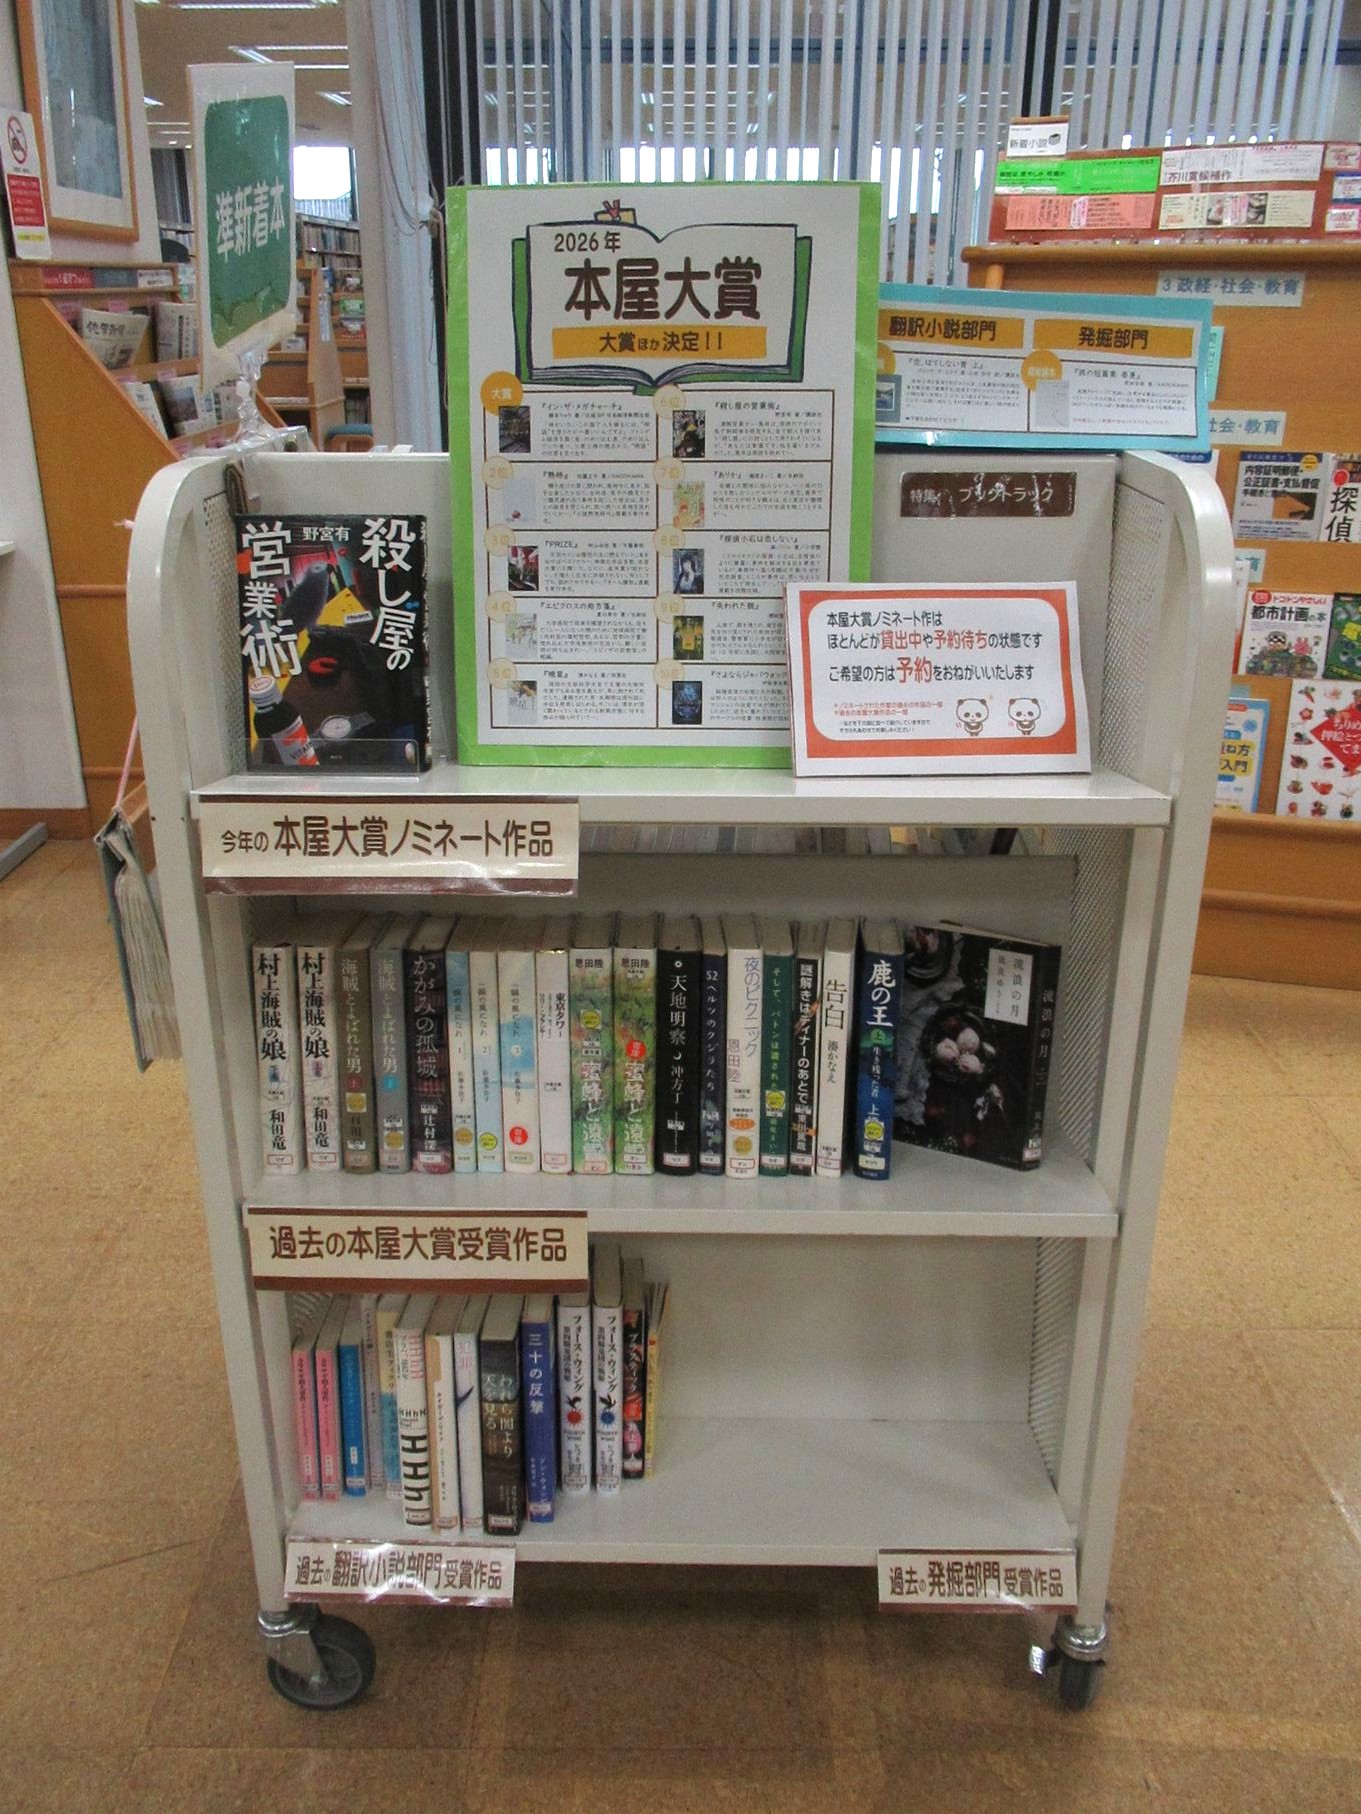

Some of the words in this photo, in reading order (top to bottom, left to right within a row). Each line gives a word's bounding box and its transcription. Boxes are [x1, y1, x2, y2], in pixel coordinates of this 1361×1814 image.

[215, 177, 285, 260] 準新着本
[554, 231, 621, 253] 2026年
[564, 256, 762, 321] 本屋大賞
[889, 316, 997, 342] 翻訳小説部門
[1078, 326, 1149, 350] 発掘部門
[491, 388, 512, 400] 大賞
[302, 526, 351, 542] 野宮有
[1325, 487, 1359, 542] 探偵
[240, 521, 302, 678] 営業術
[359, 517, 416, 671] 殺し屋の
[1251, 606, 1328, 622] 都市計画の本
[826, 611, 943, 627] 本屋大賞ノミネート作は
[827, 630, 1042, 650] ほとんどが貸出中や予約待ちの状態です
[829, 657, 1035, 683] ご希望の方は予約をおねがいいたします
[1220, 743, 1250, 756] ね方
[1220, 760, 1248, 773] 入門
[221, 815, 554, 858] 今年の本屋大賞ノミネート作品
[257, 952, 287, 1060] 村上海賊の娘
[301, 952, 330, 1060] 村上海賊の娘
[341, 958, 362, 1074] 海賊とよばれた男
[413, 956, 439, 1079] かがみの孤城
[556, 993, 566, 1038] 東京タワー
[669, 974, 687, 1045] 天地明察
[744, 956, 761, 1057] 夜のピクニック
[824, 979, 848, 1030] 告白
[866, 959, 896, 1028] 鹿の王
[705, 970, 719, 1091] 52ヘルツのクジラたち
[797, 965, 814, 1104] 謎解きはディナーのあとで
[728, 1039, 741, 1083] 恩田陸
[827, 1041, 839, 1084] 湊かなえ
[268, 1109, 287, 1151] 和田竜
[312, 1107, 330, 1148] 和田竜
[269, 1225, 567, 1262] 過去の本屋大賞受賞作品
[528, 1333, 544, 1415] 三十の反撃
[572, 1314, 584, 1393] フォース・ウィング
[606, 1314, 618, 1392] フォース・ウィング
[483, 1374, 498, 1430] 天を見る
[498, 1374, 515, 1459] われら闇より
[295, 1550, 503, 1590] 過去の翻訳小説部門受賞作品
[889, 1560, 1064, 1599] 過去の発掘部門受賞作品
